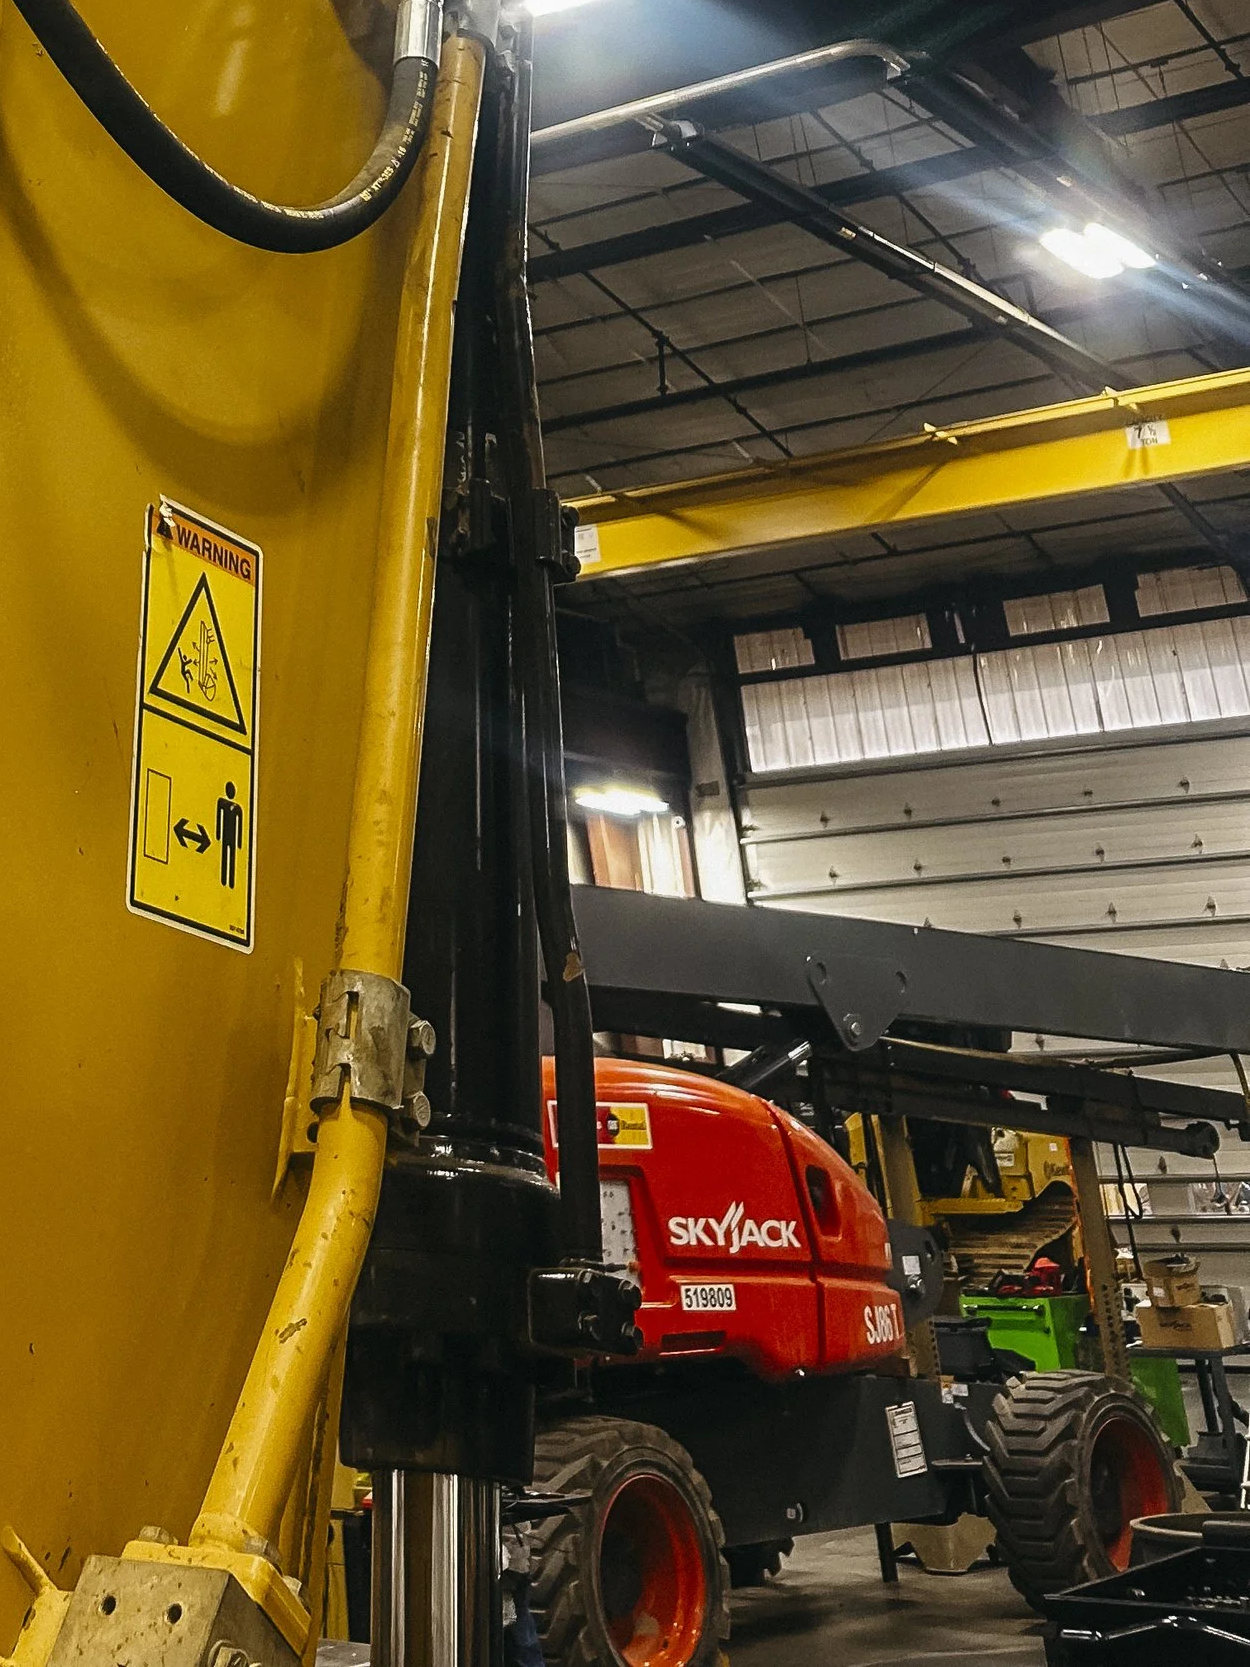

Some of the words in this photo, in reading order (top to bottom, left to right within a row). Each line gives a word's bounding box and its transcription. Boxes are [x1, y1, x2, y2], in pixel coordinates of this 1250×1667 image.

[176, 524, 251, 581] WARNING
[667, 1200, 802, 1255] SKYJACK
[684, 1286, 733, 1309] 519809
